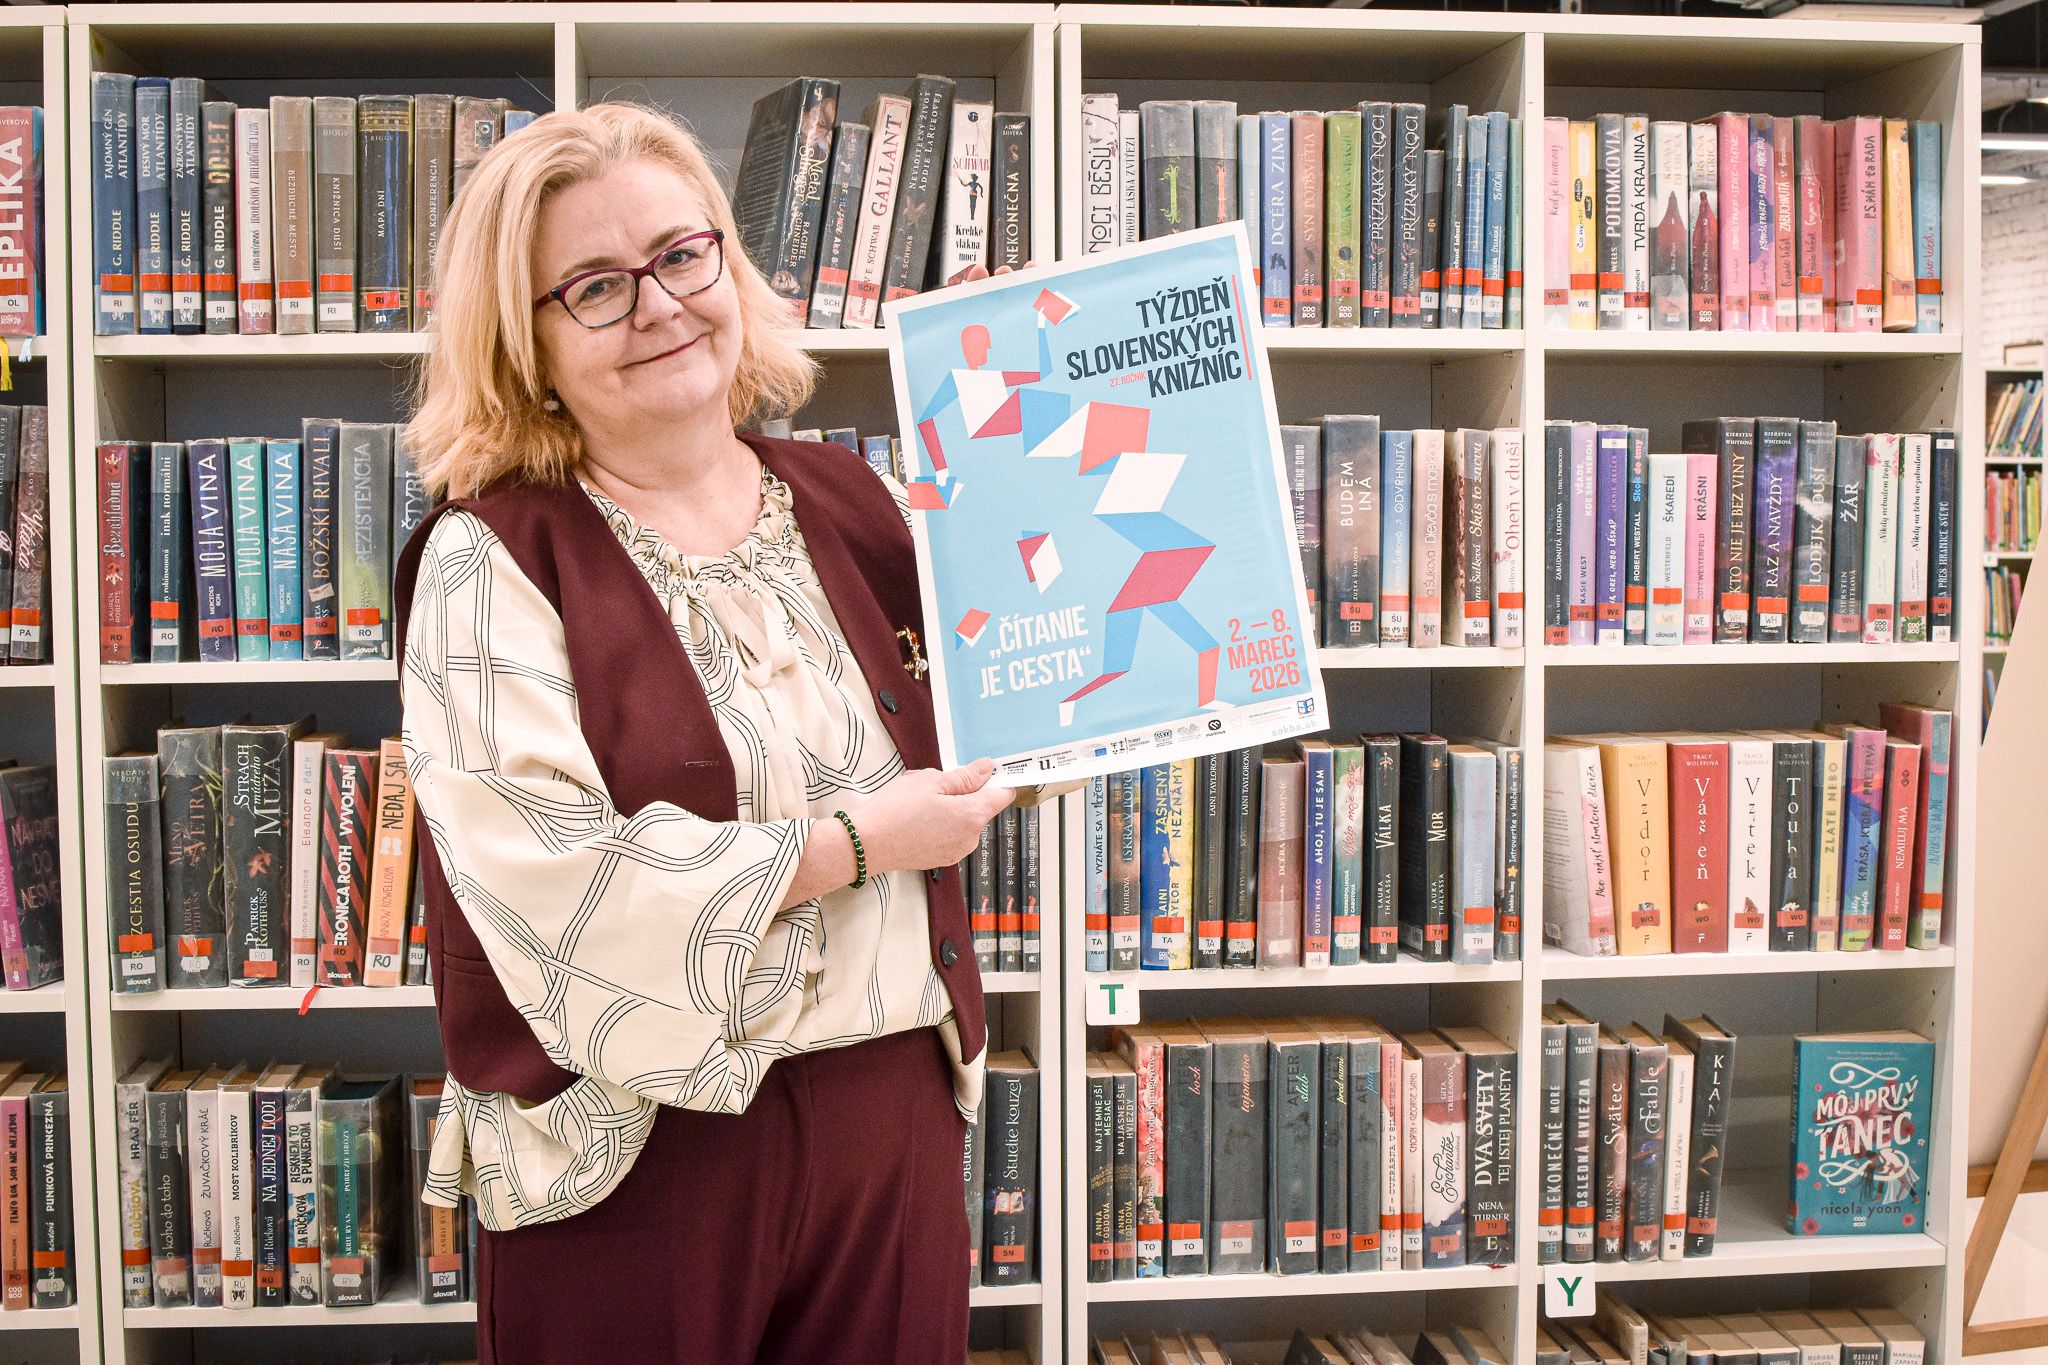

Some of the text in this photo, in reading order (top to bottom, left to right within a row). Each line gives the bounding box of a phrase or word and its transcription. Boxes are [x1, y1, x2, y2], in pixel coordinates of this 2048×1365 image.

[104, 109, 113, 179] TAJOMNÝ GÉN
[116, 112, 128, 178] ATLANTÍDY
[141, 117, 151, 176] DESIVÝ MOR
[153, 113, 166, 180] ATLANTÍDY
[185, 115, 195, 176] ATLANTÍDY
[208, 121, 229, 183] ODLET
[872, 115, 902, 216] GALLANT
[377, 190, 385, 207] DNÍ
[1269, 125, 1285, 245] DCÉRA ZIMY
[1370, 114, 1387, 240] PŘÍZRAKY NOCI
[1402, 115, 1420, 240] PŘÍZRAKY NOCI
[1606, 128, 1620, 237] POTOMKOVIA
[1631, 134, 1645, 251] TVRDÁ KRAJINA
[1778, 182, 1791, 232] ZABUCHNUTÁ
[288, 225, 296, 256] MESTO
[955, 225, 984, 236] Krehké
[955, 238, 980, 249] vlákna
[1004, 172, 1019, 264] NEKONEČNA
[1135, 276, 1230, 329] TÝŽDEŇ
[1066, 316, 1236, 382] SLOVENSKÝCH
[1121, 371, 1147, 386] ROČNÍK
[1148, 350, 1242, 398] KNIŽNÍC
[870, 450, 889, 461] GEEK
[1394, 441, 1405, 512] ODVRHNUTÁ
[160, 457, 170, 536] inak normálni
[199, 454, 226, 576] MOJA VINA
[237, 455, 261, 578] TVOJA VINA
[271, 453, 296, 569] NAŠA VINA
[310, 437, 330, 578] BOŽSKÍ RIVALI
[354, 442, 373, 565] REZISTENCIA
[1340, 461, 1353, 526] BUDEM
[1469, 442, 1482, 537] Skús to znovu
[1505, 442, 1520, 549] Oheň v duši
[1663, 476, 1674, 522] ŠKAREDÍ
[1694, 476, 1707, 521] KRÁSNI
[1841, 482, 1858, 522] ŽÁR
[1633, 512, 1641, 547] WESTALL
[1729, 453, 1744, 593] KTO NIE JE BEZ VINY
[1766, 474, 1782, 587] RAZ A NAVŽDY
[1554, 539, 1562, 580] ZABUDNUTÁ
[1228, 609, 1292, 642] 2. 8.
[1228, 635, 1297, 670] MAREC
[980, 665, 1003, 699] JE
[1249, 664, 1300, 693] 2026
[234, 744, 250, 807] STRACH
[250, 756, 262, 804] múdreho
[340, 764, 355, 836] VYVOLENÍ
[1155, 770, 1168, 834] ZASNENÝ
[1170, 765, 1182, 838] NEZNÁMY
[382, 784, 406, 829] NEDAJ
[1314, 770, 1325, 864] AHOJ, TU JE SAM
[1375, 804, 1395, 848] VÁLKA
[127, 802, 143, 957] RZCESTIA OSUDU
[338, 846, 351, 883] ROTH
[1100, 984, 1123, 1014] T
[1189, 1067, 1201, 1094] bozk
[1241, 1054, 1254, 1112] tajomstvo
[1288, 1056, 1299, 1106] AFTER
[1551, 1085, 1560, 1113] MORE
[1578, 1079, 1590, 1137] HVIEZDA
[1640, 1067, 1661, 1133] Fable
[1817, 1075, 1919, 1120] MÔJ PRVÝ
[128, 1102, 140, 1159] HRAJ FÉR
[230, 1115, 239, 1171] KOLIBRÍKOV
[1003, 1079, 1021, 1179] Studie kouzel
[1094, 1085, 1103, 1151] NAJTEMNEJŠÍ
[1103, 1100, 1111, 1135] MESIAC
[1116, 1084, 1125, 1155] NAJJASNEJŠIE
[1126, 1099, 1134, 1139] HVIEZDY
[1474, 1068, 1494, 1186] DVA SVETY
[1499, 1068, 1511, 1184] TEJ ISTEJ PLANÉTY
[1604, 1083, 1626, 1153] Svätec
[1815, 1112, 1912, 1161] TANEC
[43, 1101, 54, 1211] PUNKOVÁ PRINCEZNÁ
[198, 1136, 210, 1199] ŽUVAČKOVÝ
[262, 1134, 276, 1181] JEDNEJ
[161, 1175, 173, 1249] koho do toho
[262, 1185, 276, 1202] NA
[1478, 1201, 1503, 1210] NENA
[1821, 1202, 1901, 1219] nicola yoon
[1557, 1277, 1582, 1306] Y
